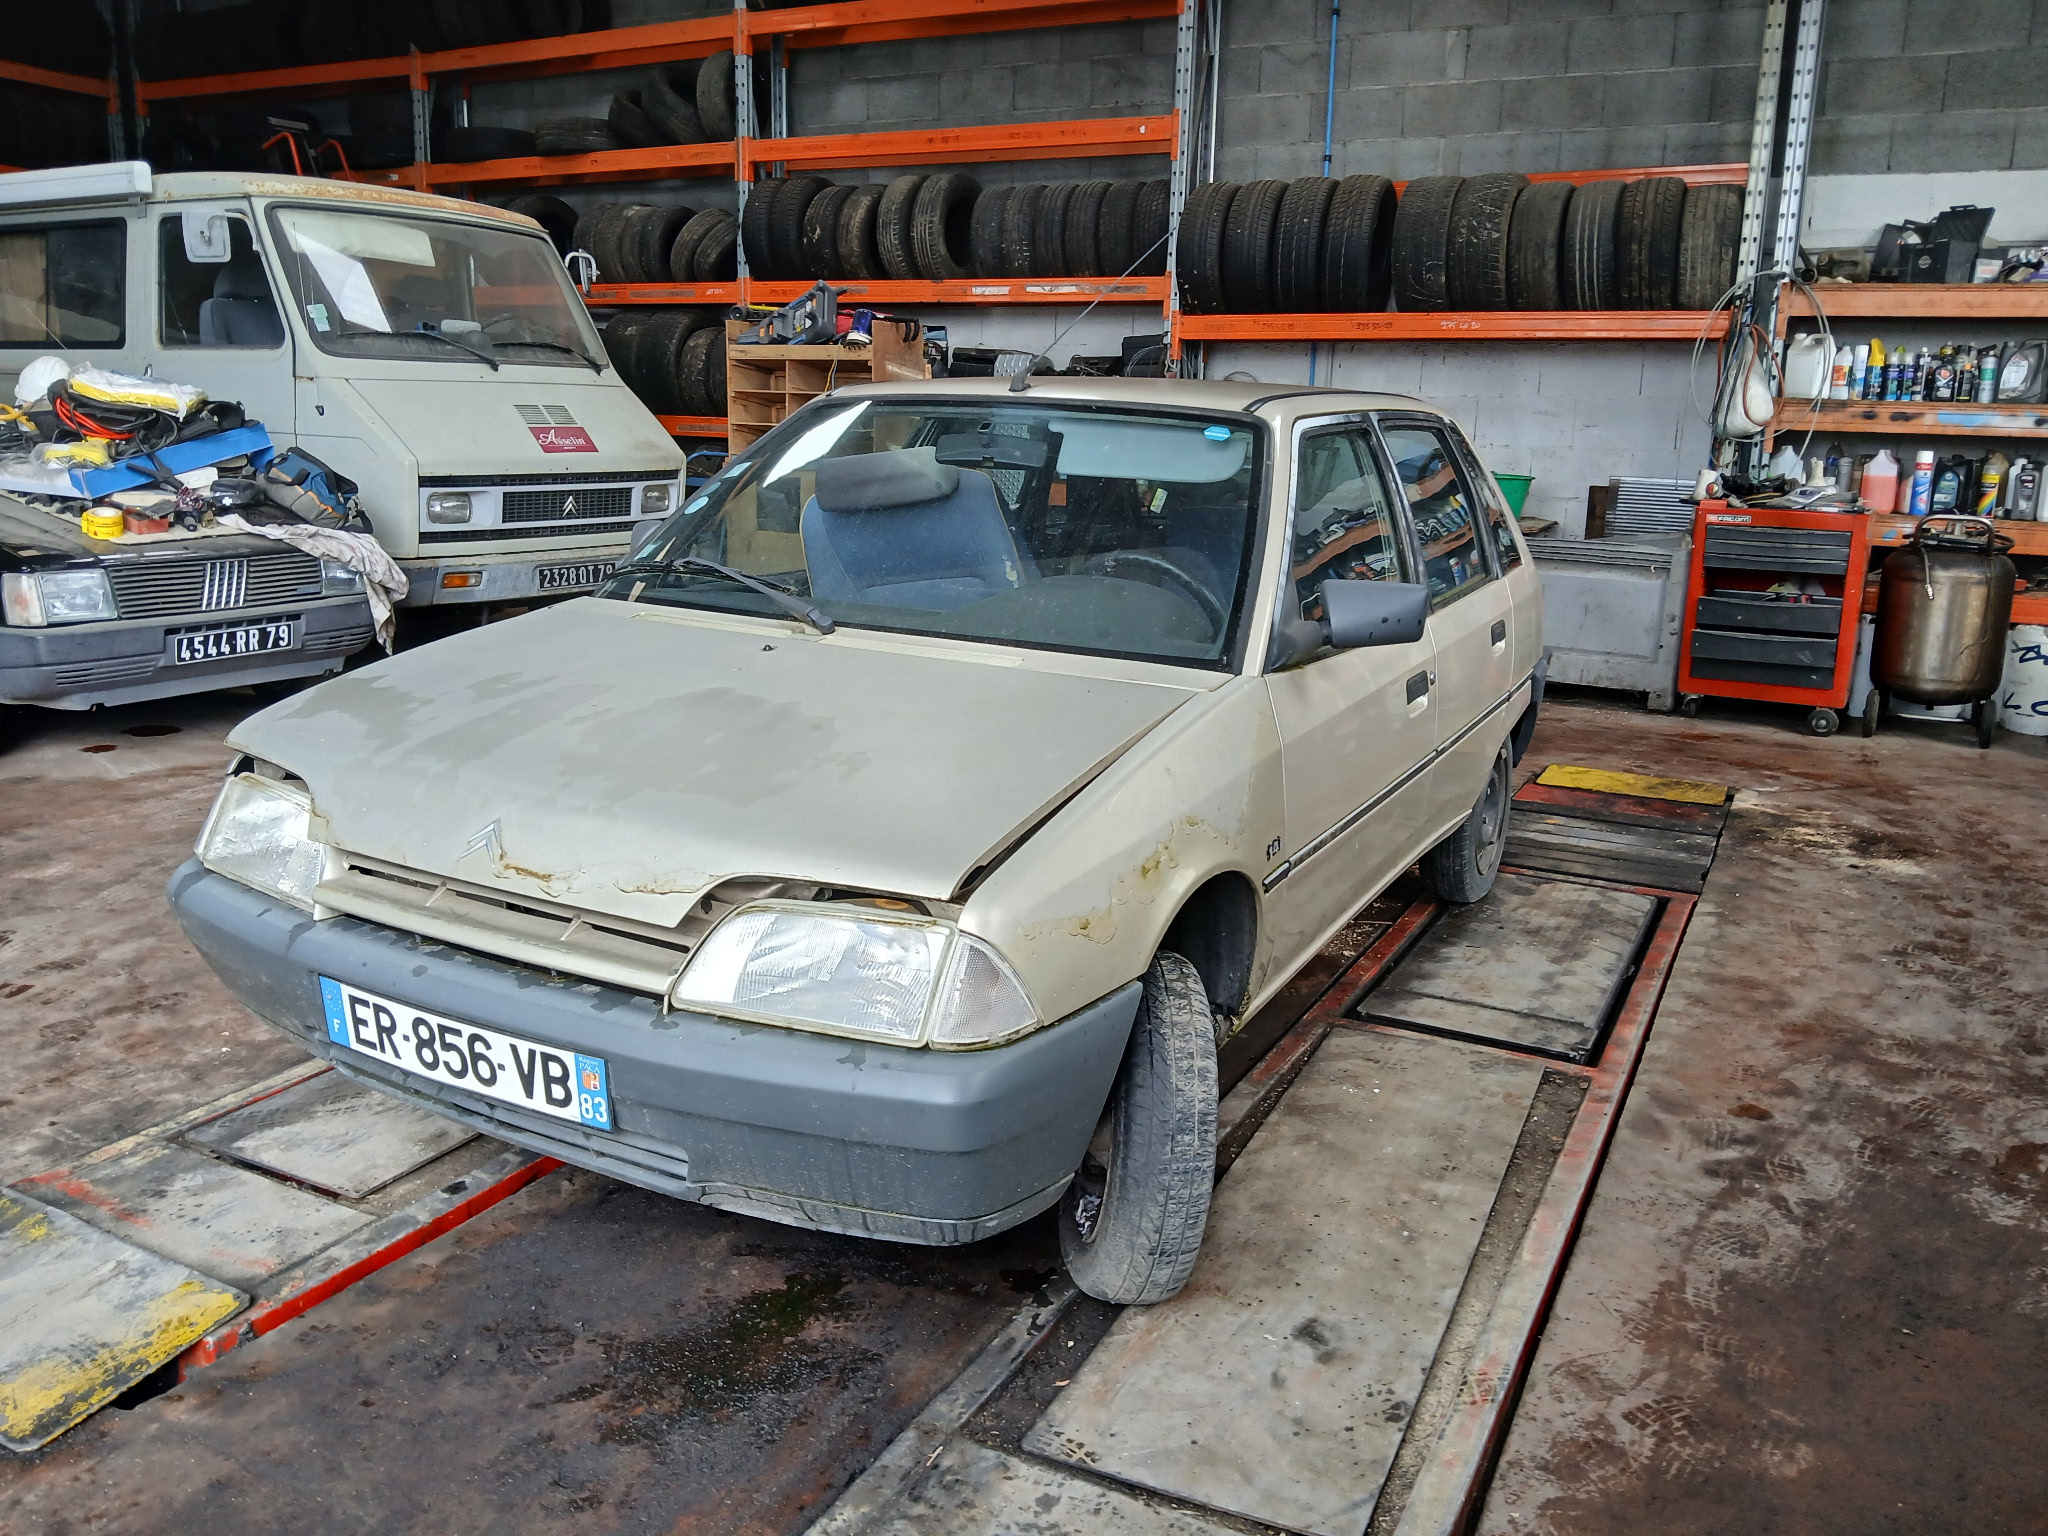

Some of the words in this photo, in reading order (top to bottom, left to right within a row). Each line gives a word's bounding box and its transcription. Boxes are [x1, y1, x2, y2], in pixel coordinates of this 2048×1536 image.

[538, 428, 587, 445] Asselin
[543, 567, 577, 588] 2328
[180, 633, 231, 660] 4544
[235, 629, 260, 652] RR
[266, 625, 289, 648] 79
[332, 1018, 341, 1033] F
[348, 993, 573, 1109] ER-856-VB
[579, 1062, 601, 1074] PACA
[580, 1092, 608, 1123] 83
